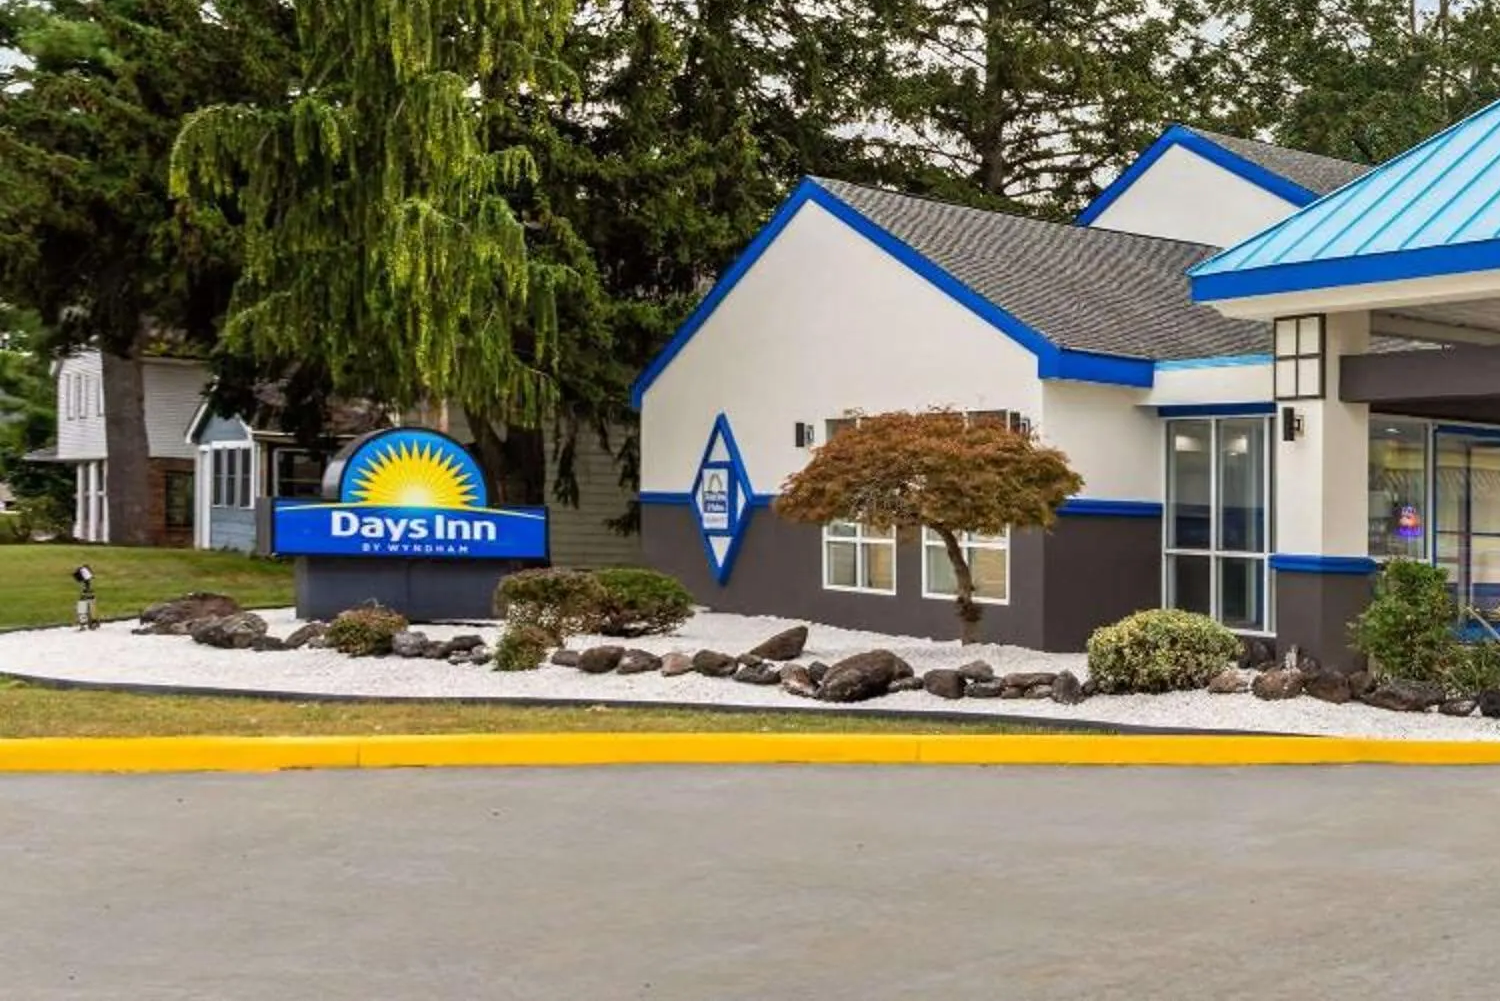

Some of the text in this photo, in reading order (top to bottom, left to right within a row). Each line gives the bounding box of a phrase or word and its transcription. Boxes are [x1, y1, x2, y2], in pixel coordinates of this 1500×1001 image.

[331, 510, 497, 542] Days Inn
[362, 543, 470, 554] BY WYNDHAM
